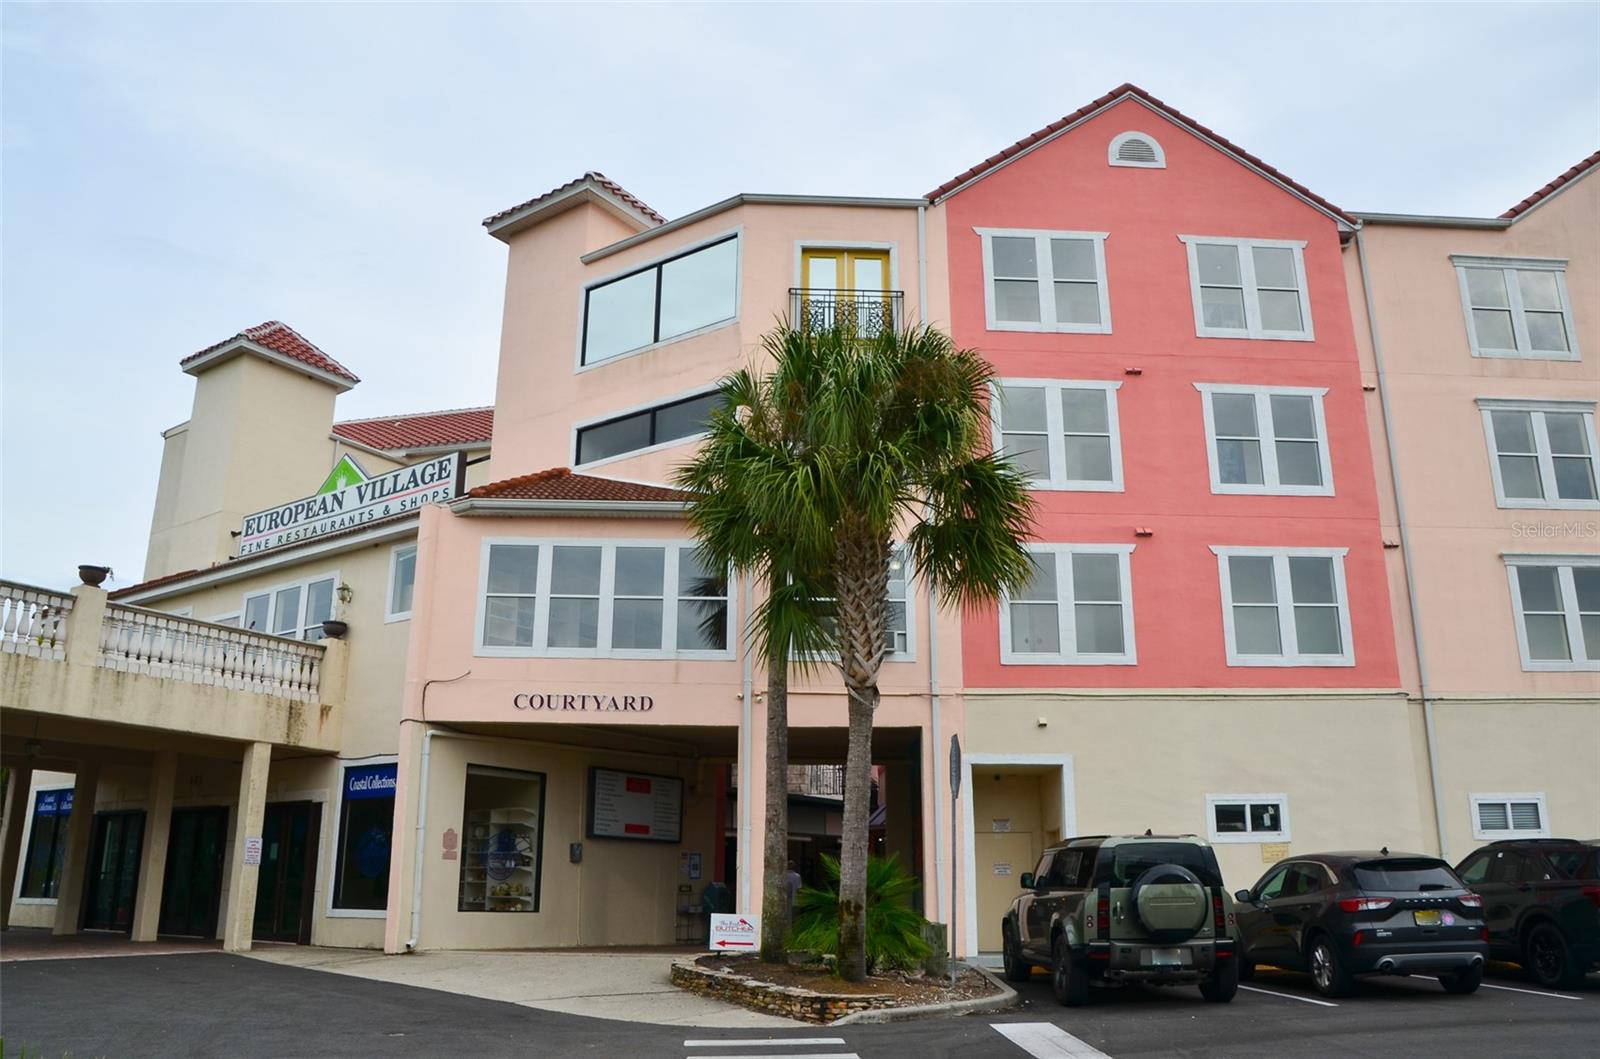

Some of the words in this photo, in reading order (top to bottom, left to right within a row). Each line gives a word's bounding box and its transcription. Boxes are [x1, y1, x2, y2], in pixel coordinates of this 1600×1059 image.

[243, 490, 346, 538] EUROPEAN
[356, 458, 452, 505] VILLAGE
[240, 538, 271, 555] FINE
[277, 509, 374, 545] RESTAURANTS
[382, 504, 391, 516] &
[400, 487, 450, 511] SHOPS
[513, 693, 654, 712] COURTYARD
[350, 776, 368, 791] Coastal
[368, 775, 396, 789] Collections
